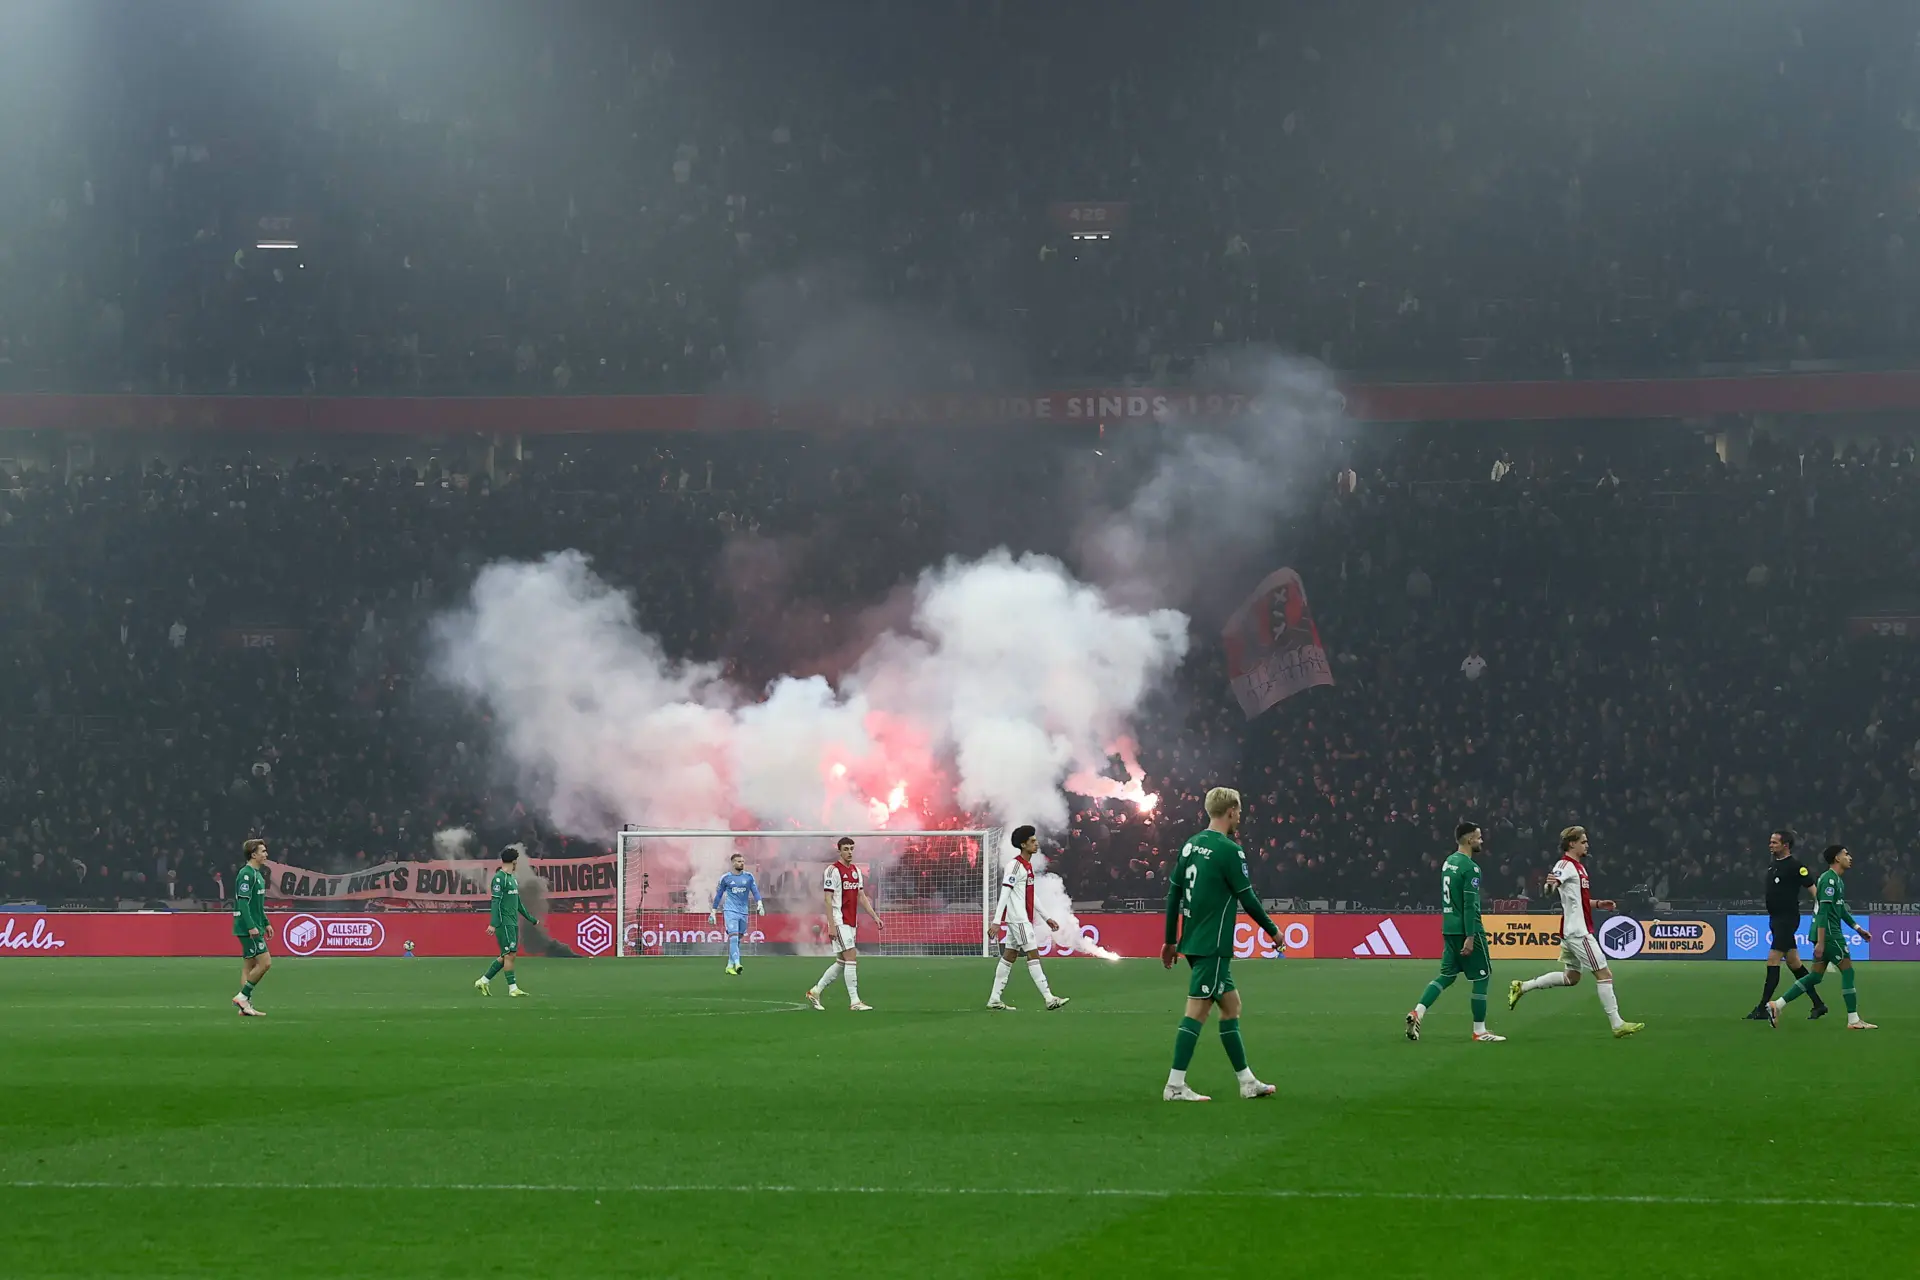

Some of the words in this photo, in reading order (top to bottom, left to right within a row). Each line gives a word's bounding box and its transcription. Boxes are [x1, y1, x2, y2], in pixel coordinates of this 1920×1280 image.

[1067, 395, 1168, 418] SINDS
[280, 871, 342, 897] GAAT
[347, 867, 410, 894] NIETS
[416, 867, 488, 895] BOVEN
[332, 924, 368, 935] ALLSAFE
[1506, 922, 1532, 930] TEAM
[1654, 925, 1698, 937] ALLSAFE
[623, 923, 765, 947] Coinmee
[326, 937, 343, 946] MINI
[344, 937, 373, 946] OPSLAG
[1648, 940, 1668, 950] MINI
[1669, 940, 1704, 951] OPSLAG
